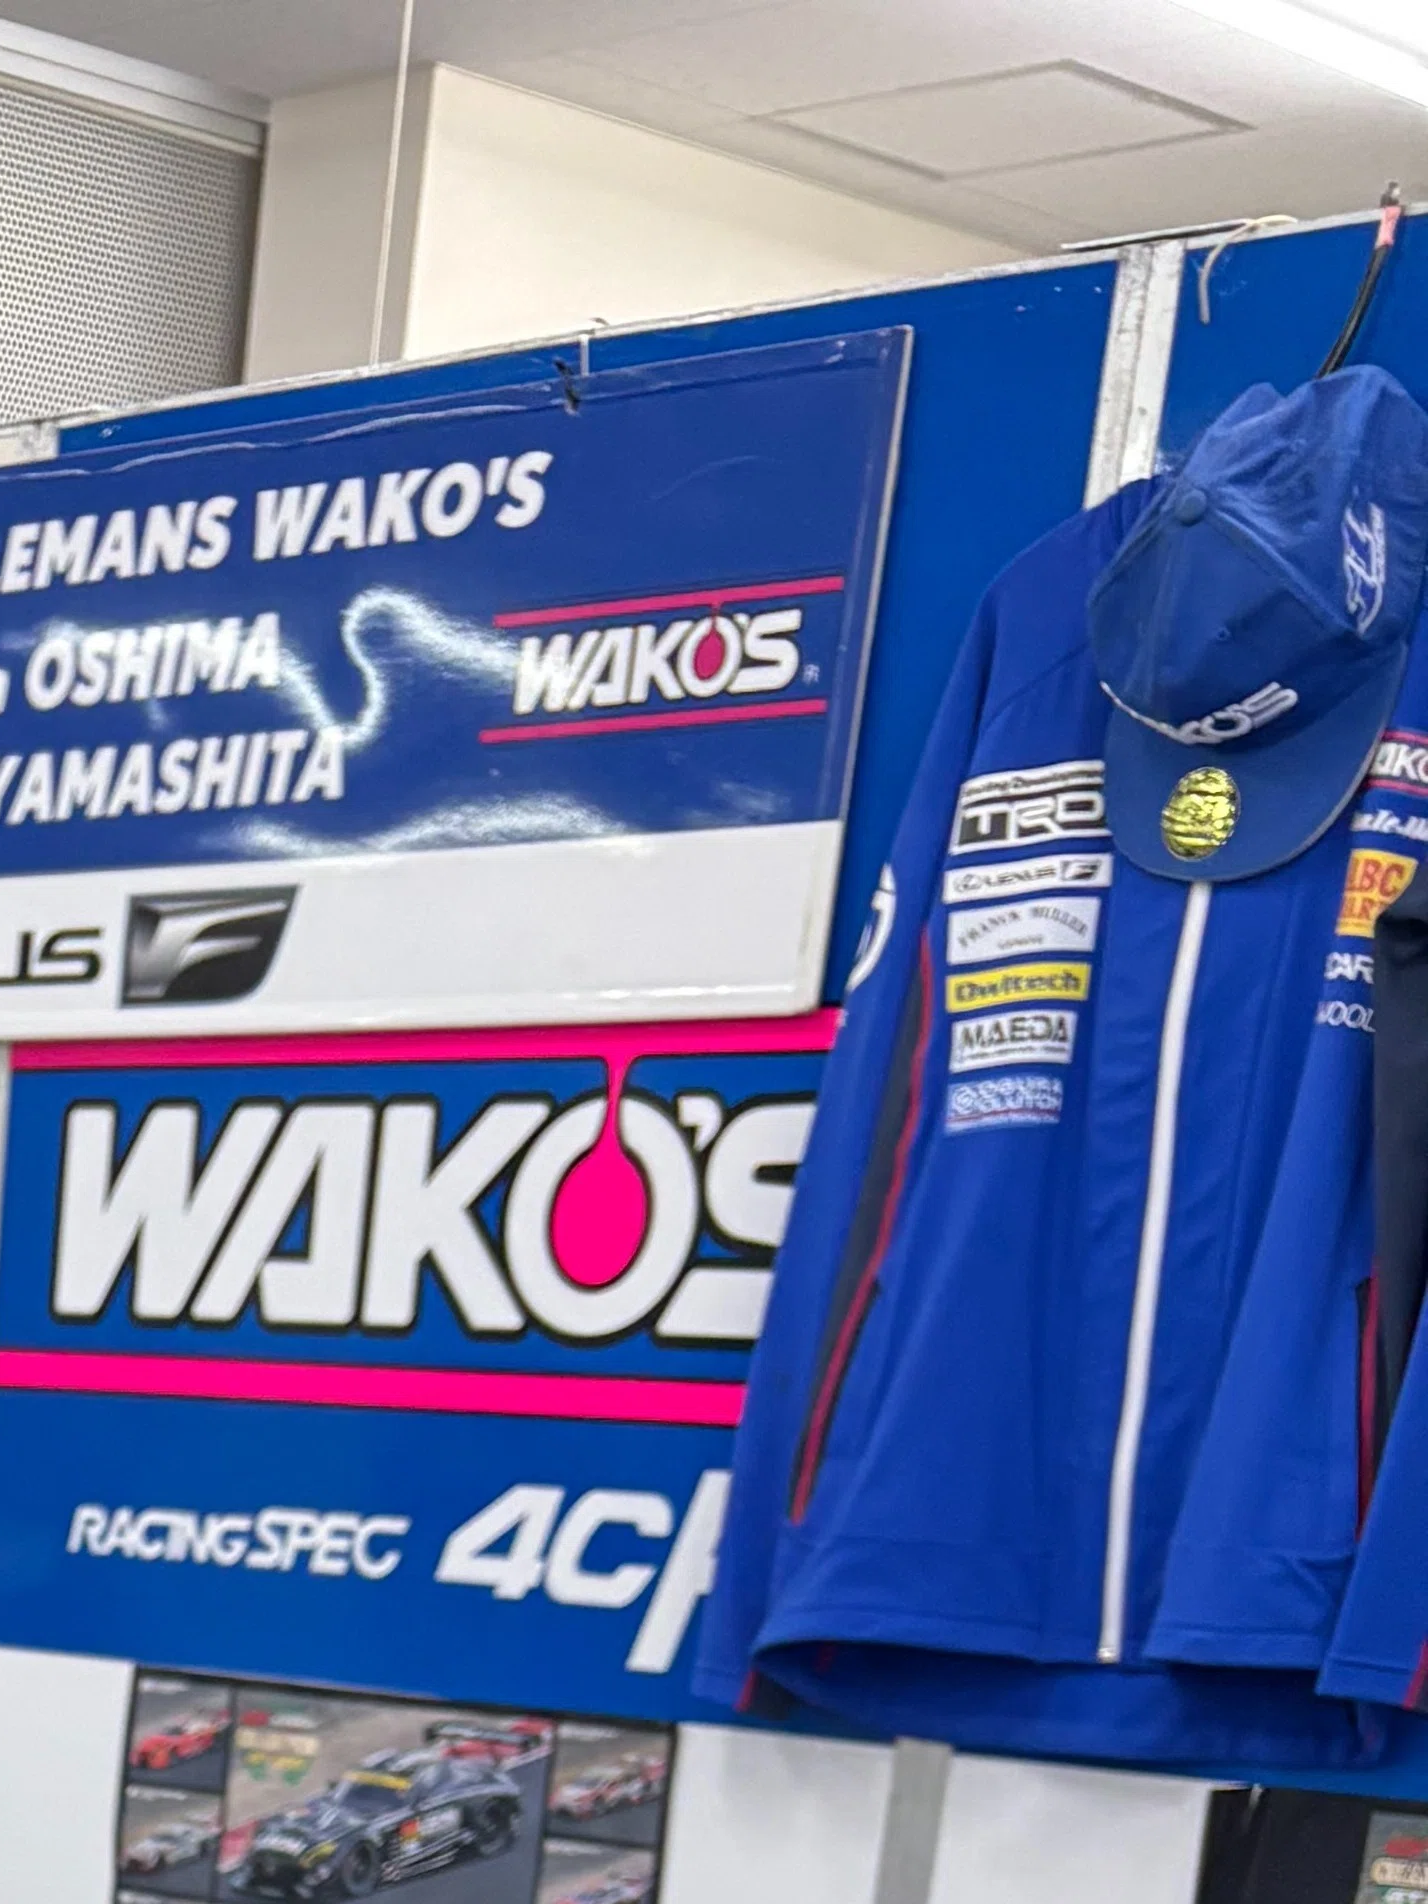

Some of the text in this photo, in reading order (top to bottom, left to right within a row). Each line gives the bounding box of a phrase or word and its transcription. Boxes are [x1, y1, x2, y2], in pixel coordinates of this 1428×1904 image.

[253, 450, 554, 563] WAKO'S
[24, 611, 282, 712] OSHIMA
[512, 607, 804, 716] WAKO'S
[960, 789, 1105, 844] TRD
[961, 1015, 1069, 1049] MAEDA
[52, 1092, 816, 1342] WAKO'S
